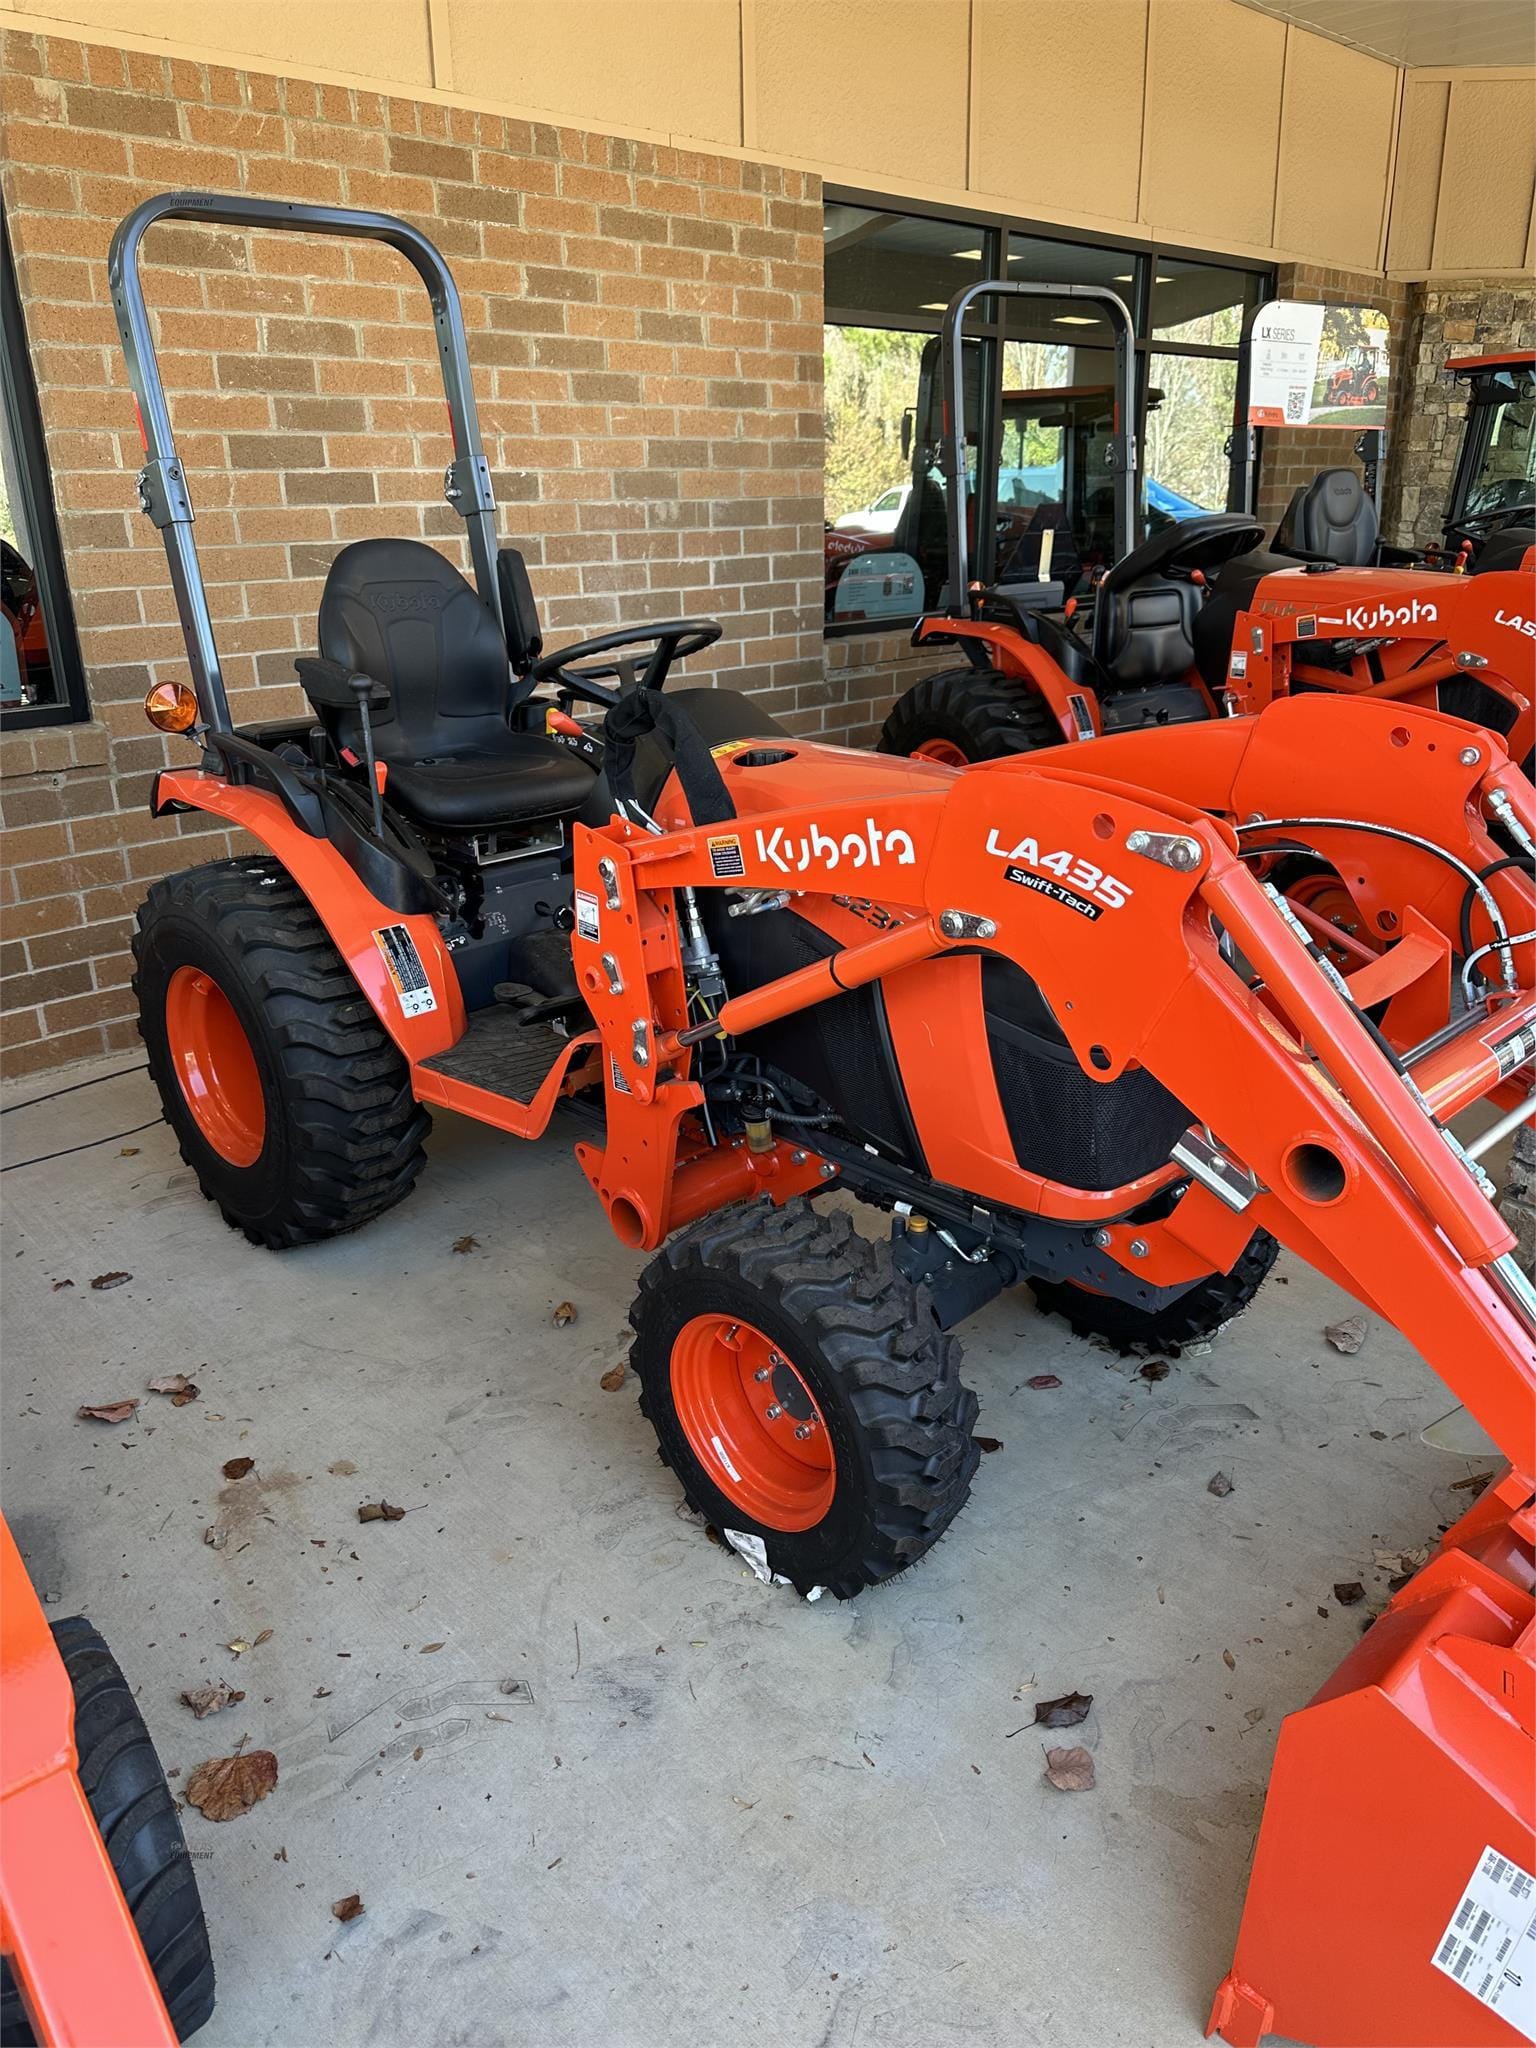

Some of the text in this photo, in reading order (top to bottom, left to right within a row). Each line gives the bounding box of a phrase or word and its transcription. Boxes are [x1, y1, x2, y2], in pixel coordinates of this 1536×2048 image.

[1261, 326, 1296, 341] LX SERIES
[1346, 598, 1437, 631] Kubota
[1494, 609, 1536, 640] LA5
[755, 818, 916, 873] Kubota
[985, 828, 1134, 909] LA435
[1009, 869, 1096, 918] Swift-Tach
